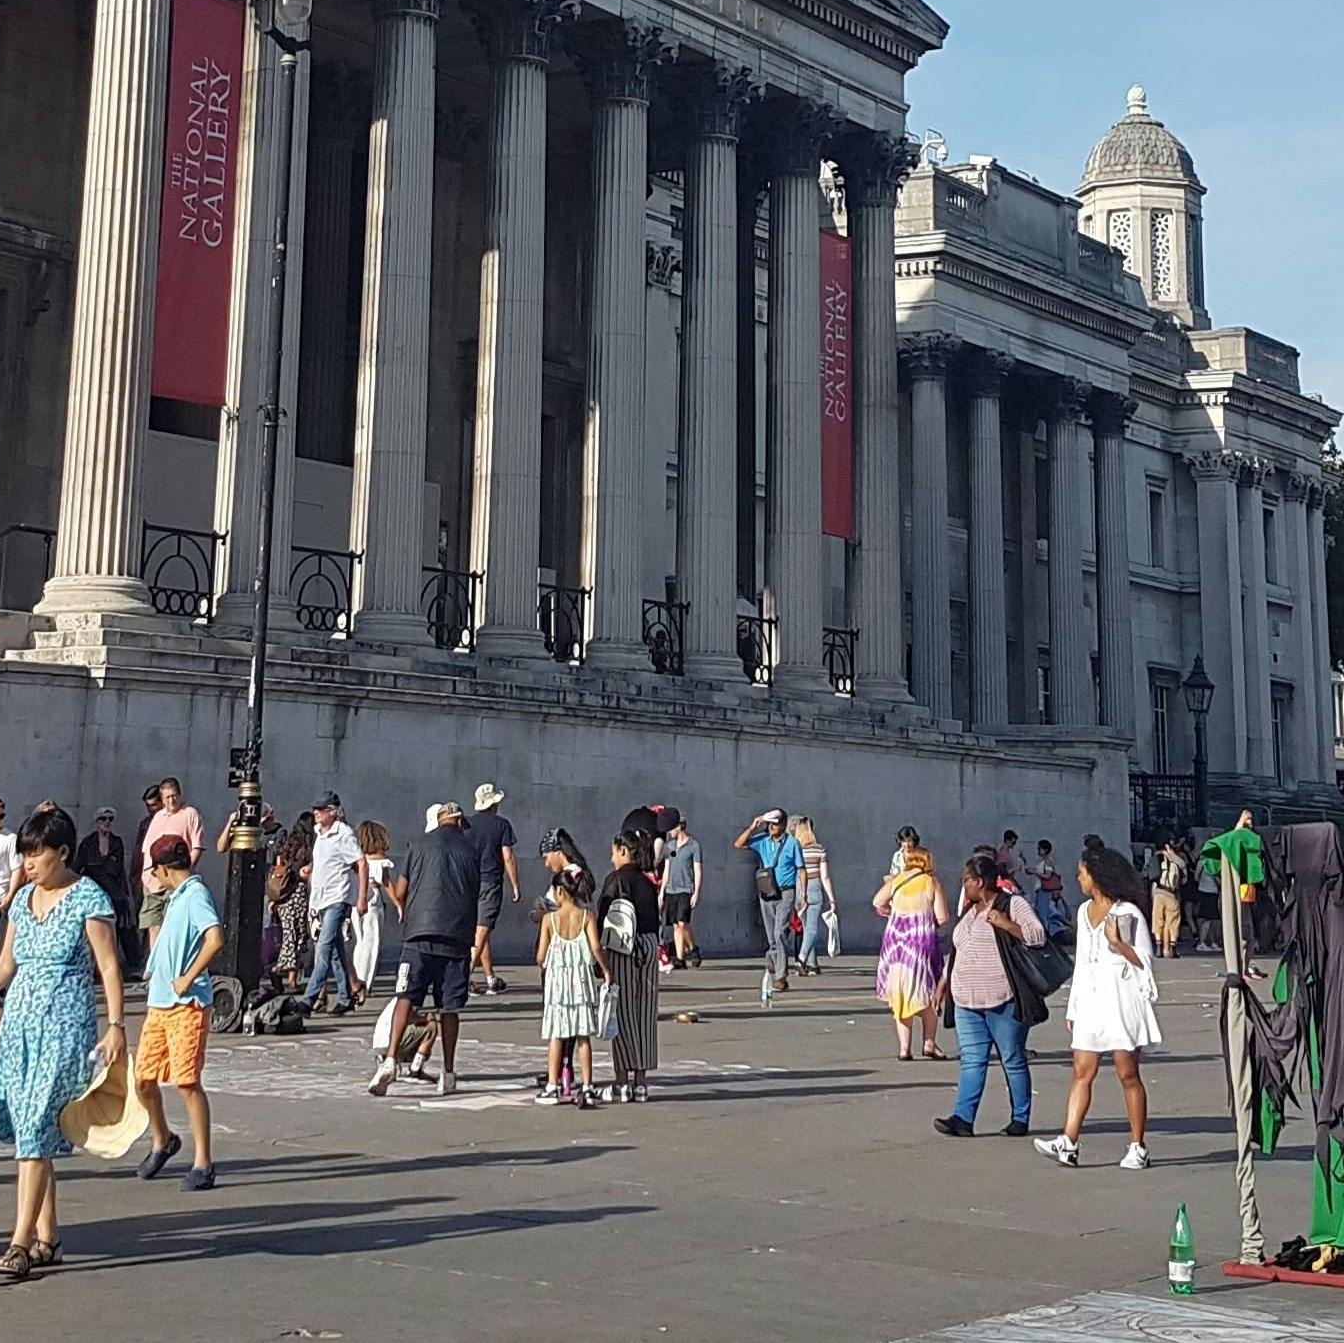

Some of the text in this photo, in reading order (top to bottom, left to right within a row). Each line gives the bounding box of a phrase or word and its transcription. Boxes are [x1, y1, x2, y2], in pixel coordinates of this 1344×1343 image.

[171, 152, 183, 189] THE
[178, 56, 209, 243] NATIONAL
[201, 59, 231, 248] GALLERY
[824, 278, 835, 417] NATIONAL
[835, 280, 847, 423] GALLERY
